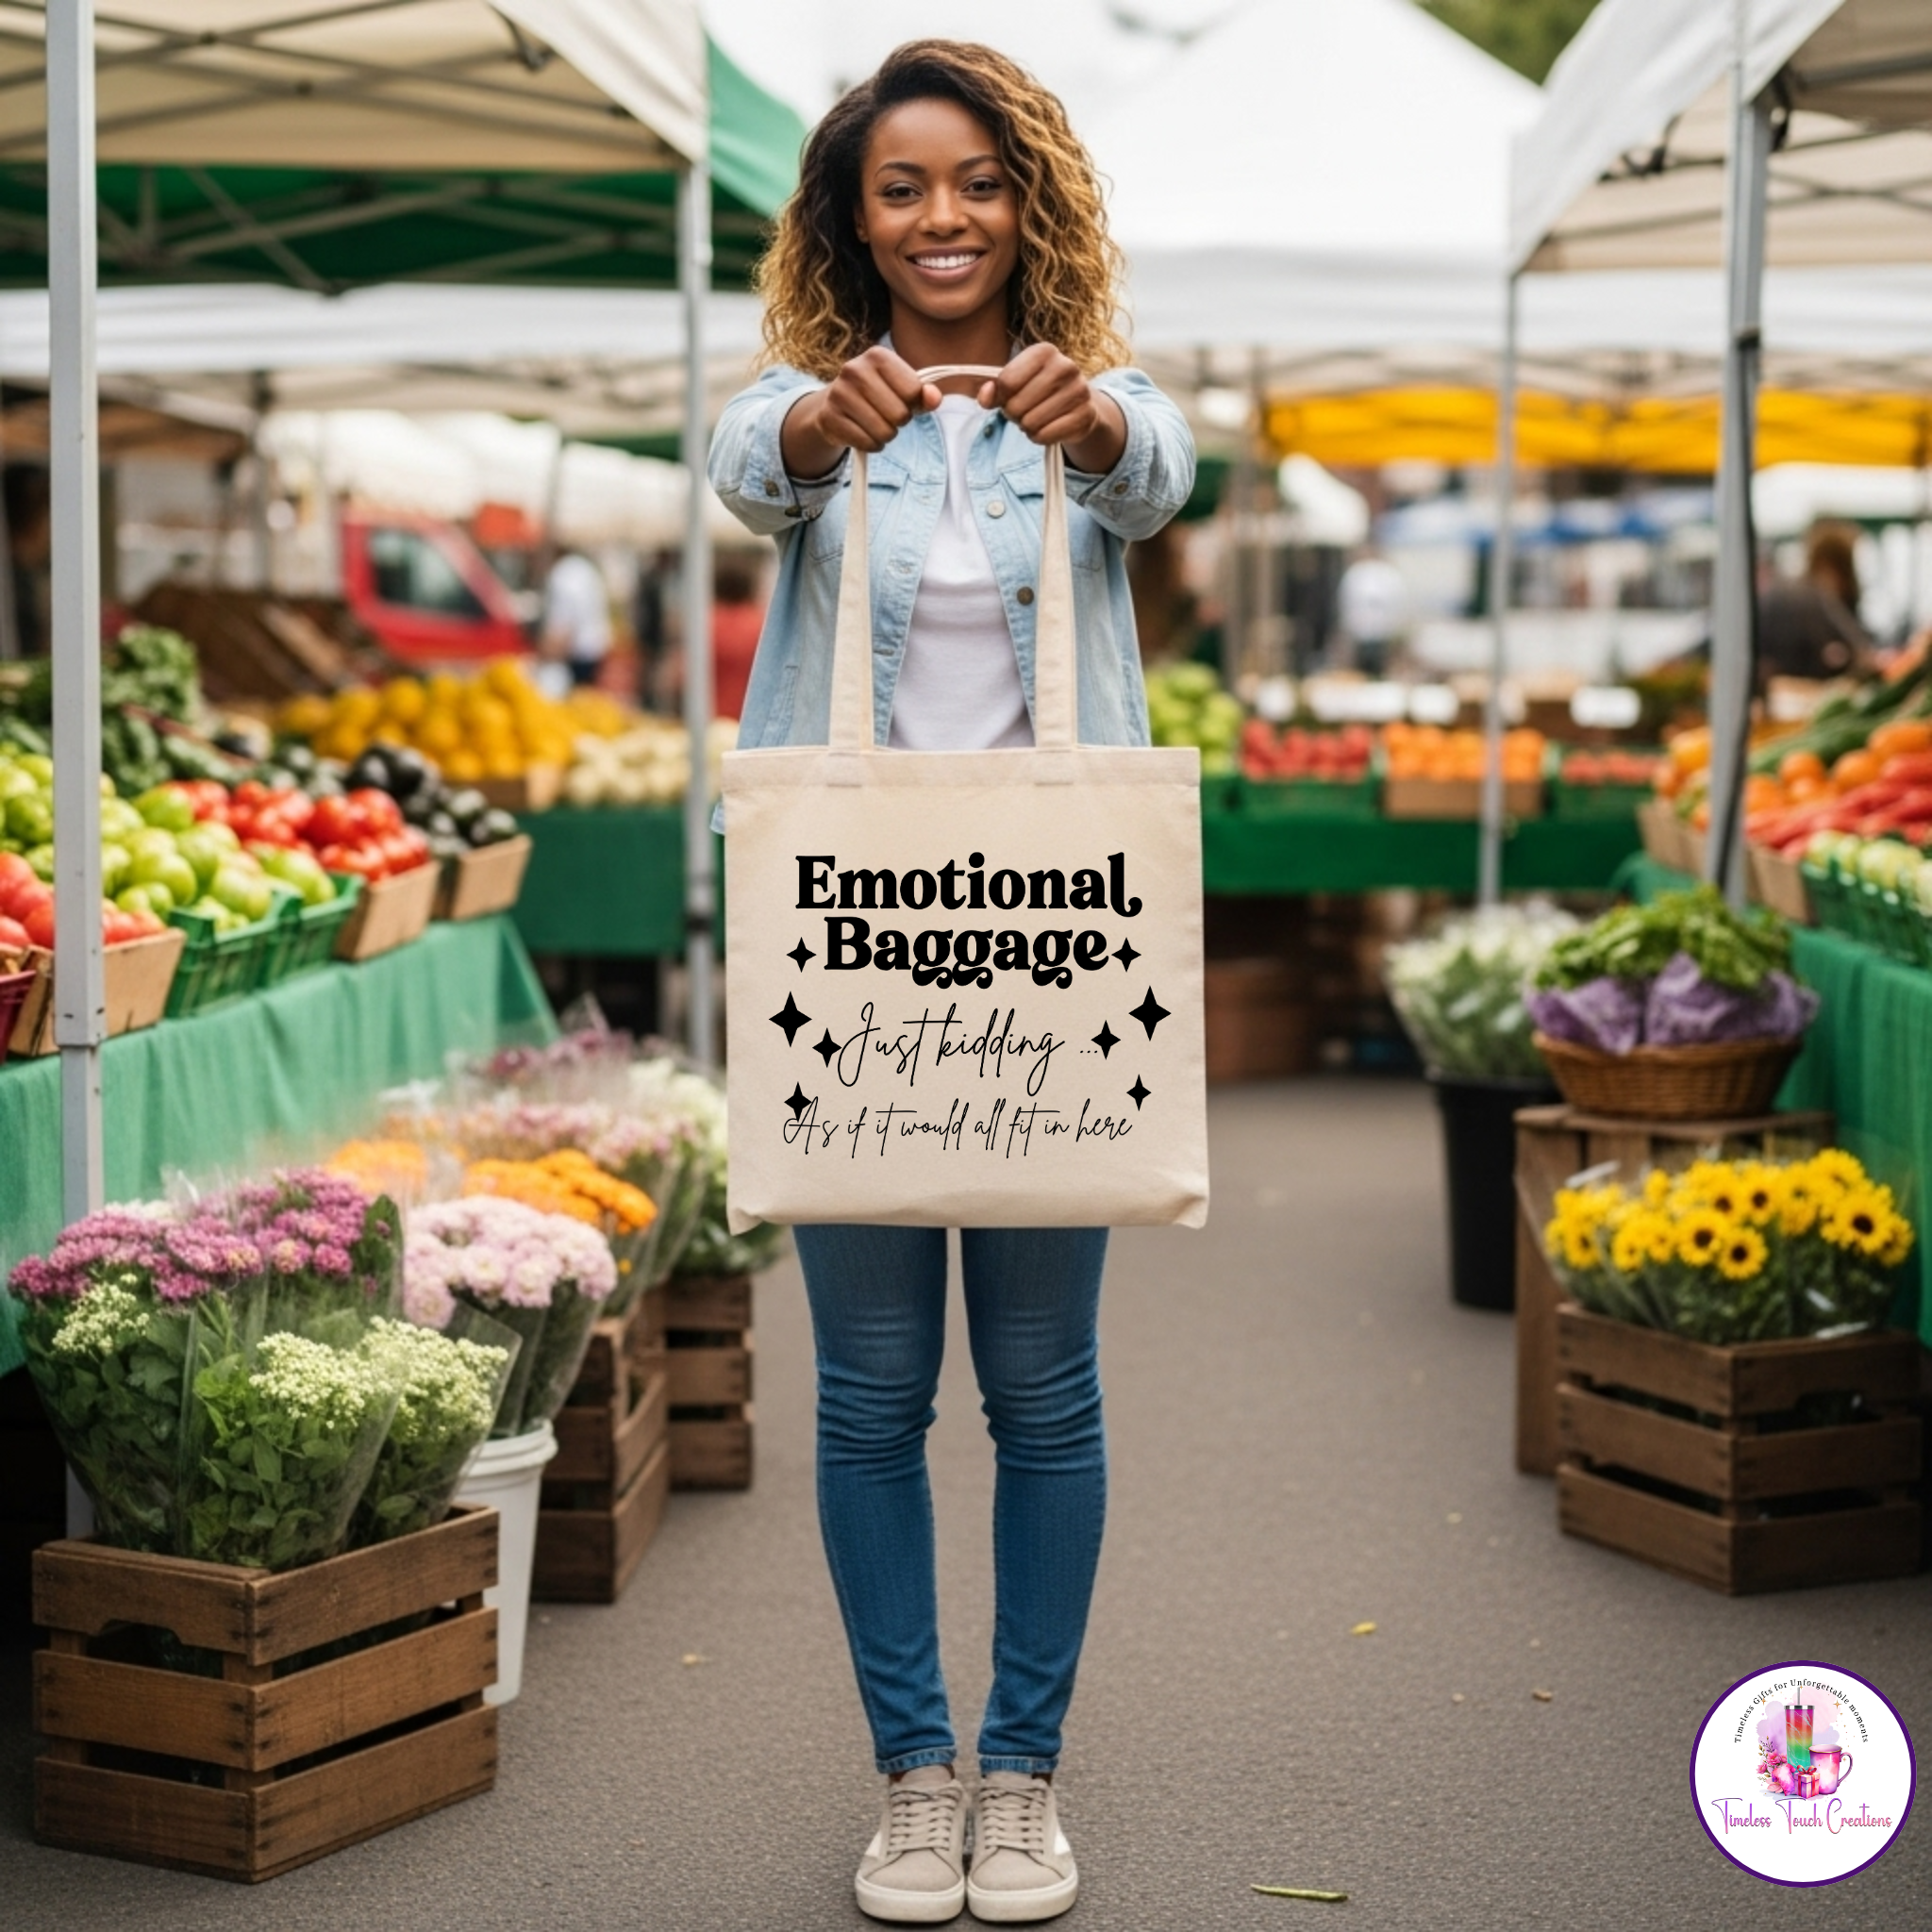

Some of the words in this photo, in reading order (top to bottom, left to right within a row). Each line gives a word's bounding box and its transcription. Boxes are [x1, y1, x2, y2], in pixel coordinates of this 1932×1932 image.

[796, 852, 1143, 918] Emotional
[824, 916, 1109, 990] Baggage
[837, 1001, 957, 1088] Just
[936, 1002, 1066, 1097] kidding
[783, 1095, 840, 1156] As
[847, 1106, 868, 1159] if
[875, 1102, 914, 1157] it
[901, 1098, 970, 1151] would
[974, 1098, 1007, 1151] all
[1006, 1102, 1060, 1159] fit
[1044, 1119, 1070, 1136] in
[1075, 1098, 1133, 1142] here
